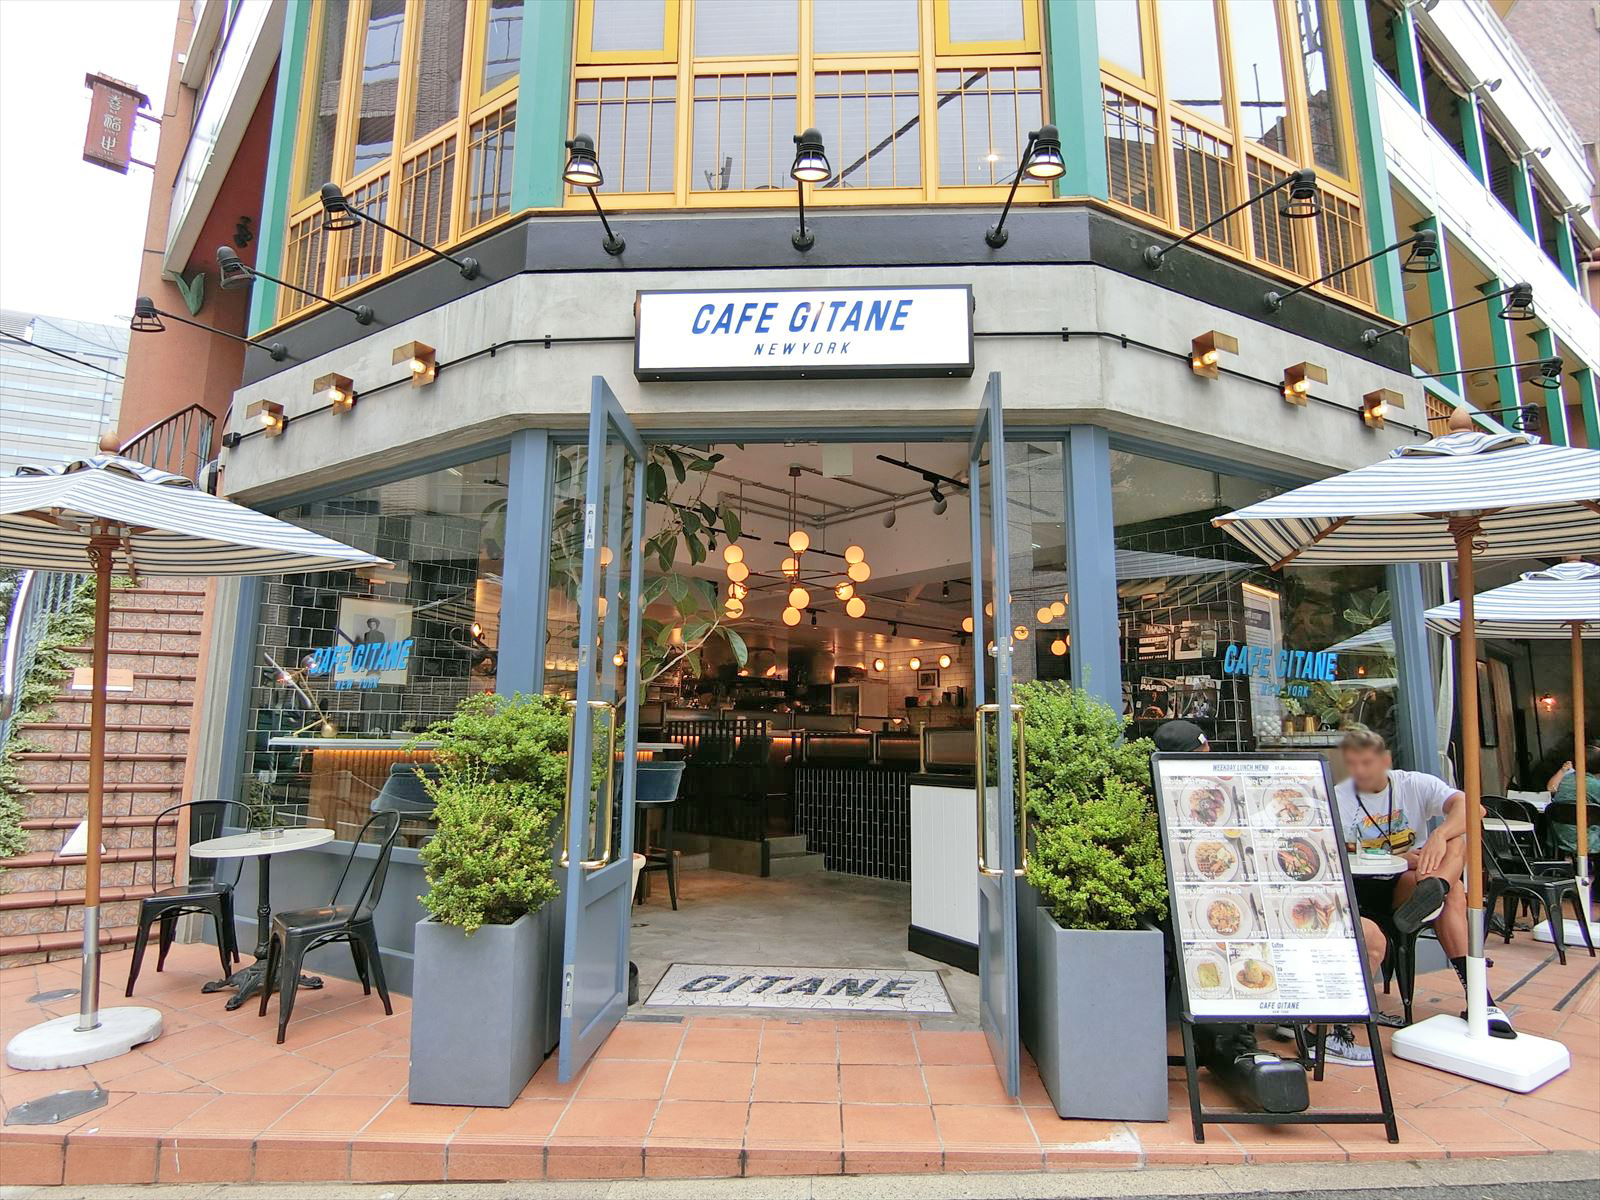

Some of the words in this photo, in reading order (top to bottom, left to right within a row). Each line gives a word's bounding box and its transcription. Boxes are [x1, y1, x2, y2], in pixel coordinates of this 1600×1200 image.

[691, 301, 779, 336] CAFE
[788, 298, 914, 334] GITANE
[310, 645, 351, 674] CAFE
[352, 639, 415, 673] GITANE
[1224, 643, 1273, 679] CAFE
[1275, 649, 1339, 681] GITANE
[1140, 684, 1168, 692] PAPER
[1287, 685, 1310, 698] YORK
[1213, 764, 1236, 772] WEEKDAY
[1237, 764, 1254, 772] LUNCH
[1255, 764, 1270, 772] MENU
[678, 974, 919, 998] GITANE
[1259, 1001, 1275, 1010] CAFE
[1277, 1001, 1300, 1010] GITANE
